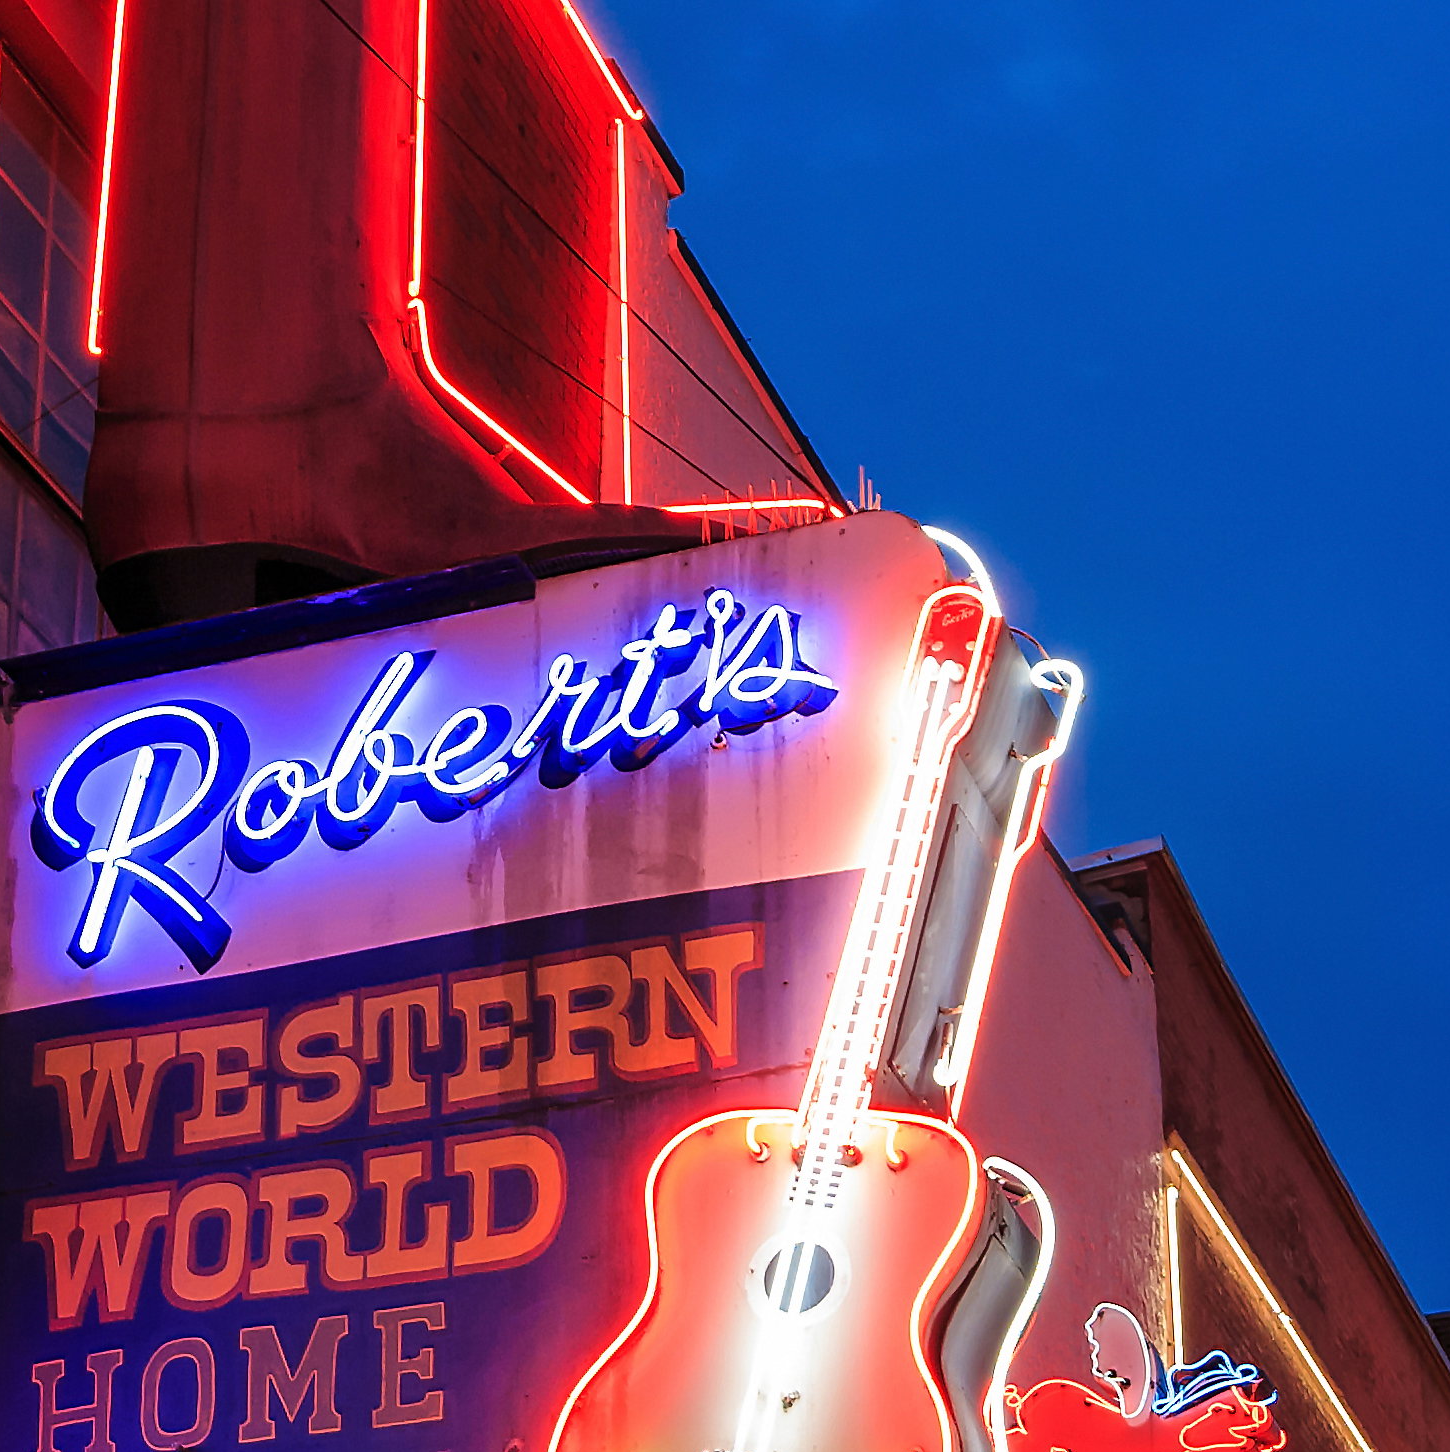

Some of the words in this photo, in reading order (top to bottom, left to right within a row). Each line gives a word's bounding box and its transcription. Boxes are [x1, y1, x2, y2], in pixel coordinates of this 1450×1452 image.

[31, 586, 838, 974] Robert's
[33, 923, 765, 1171] WESTERN
[25, 1126, 568, 1332] WORLD
